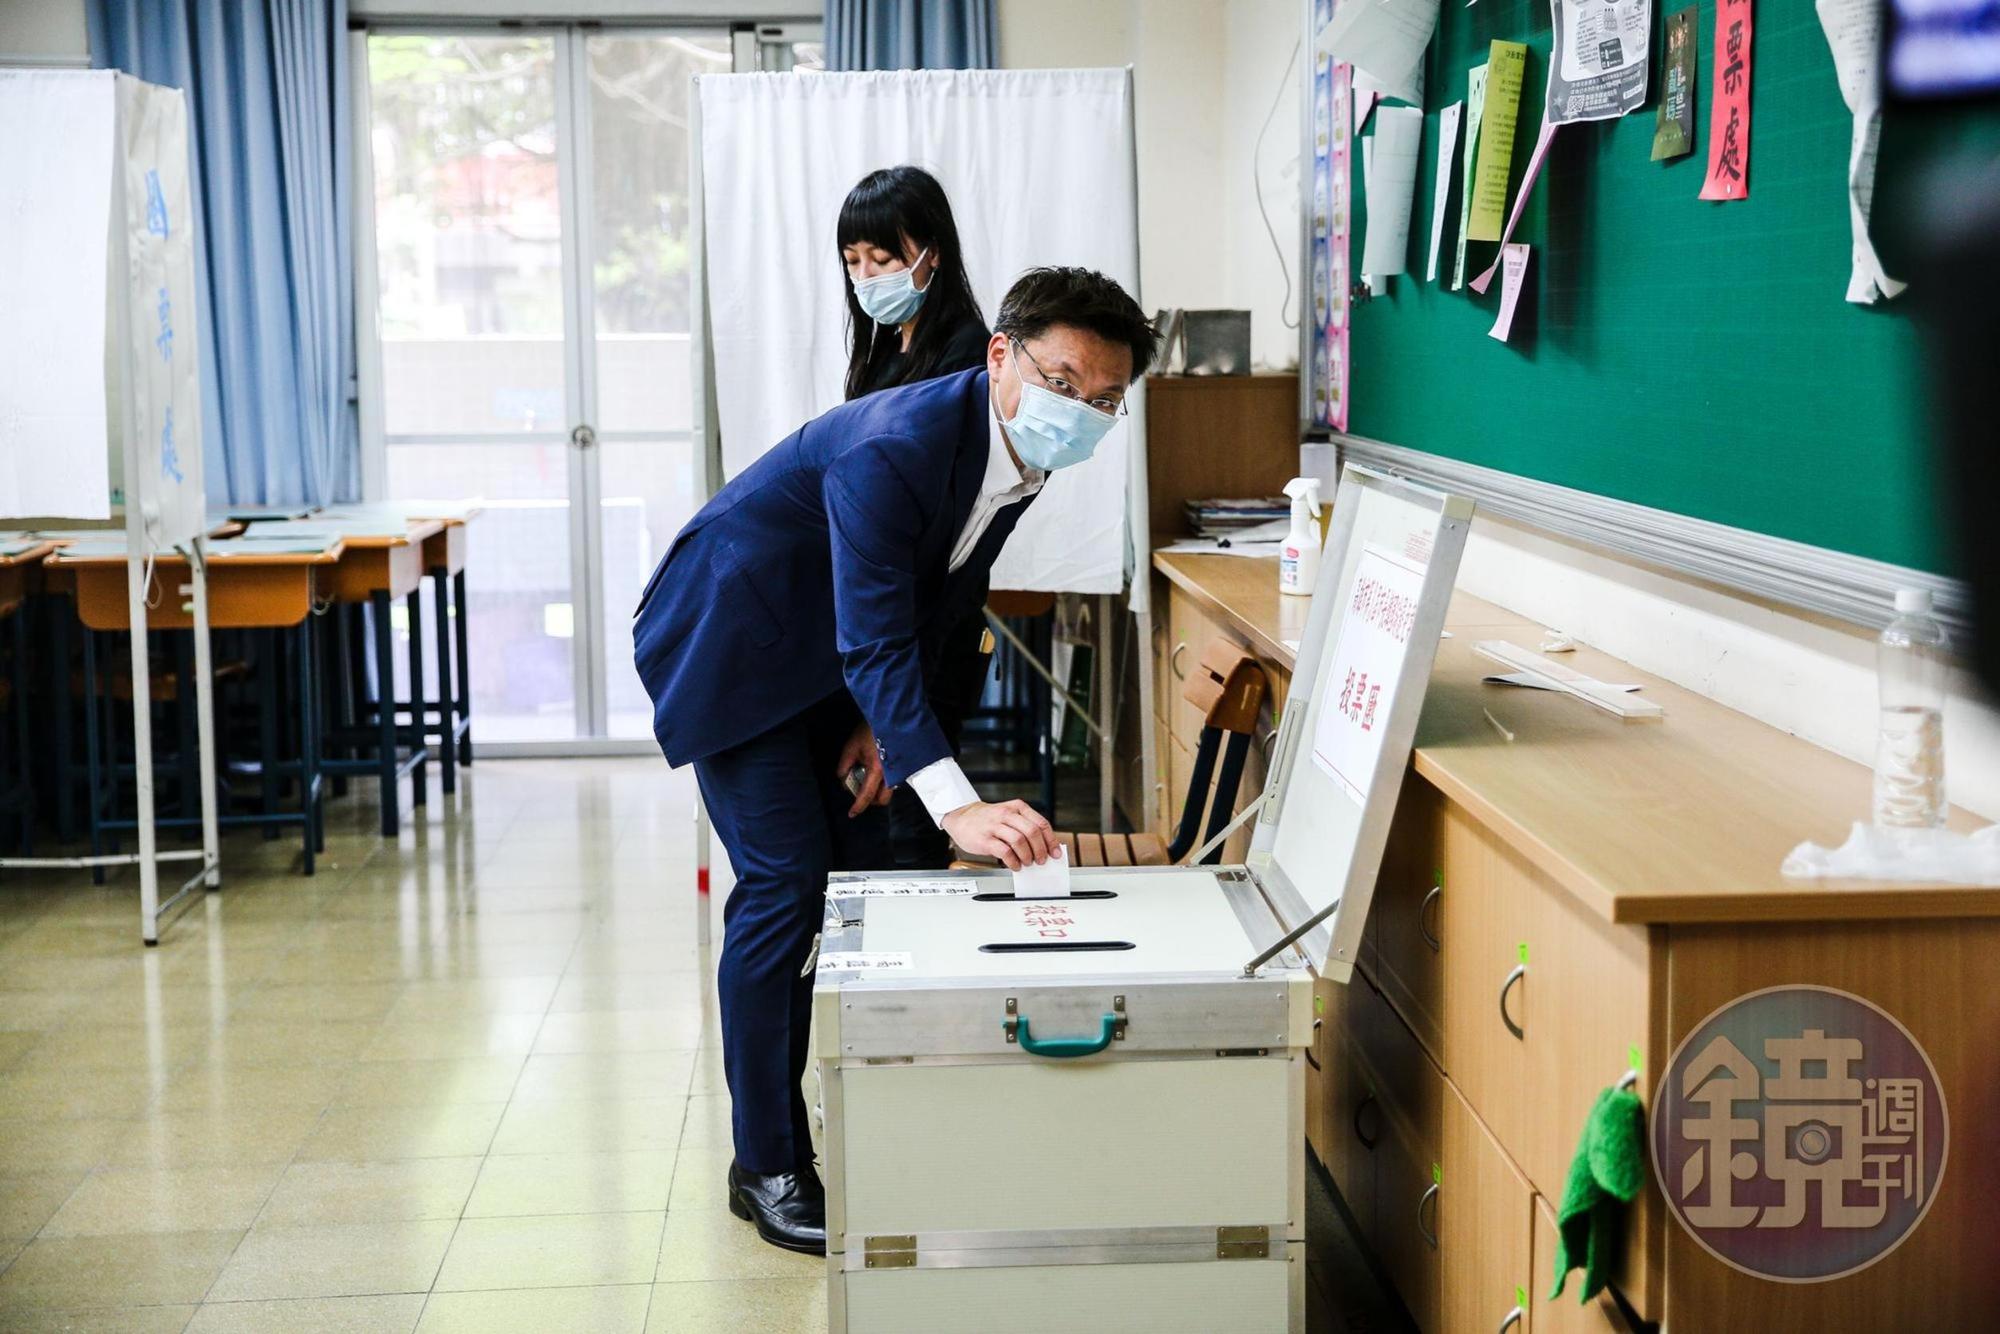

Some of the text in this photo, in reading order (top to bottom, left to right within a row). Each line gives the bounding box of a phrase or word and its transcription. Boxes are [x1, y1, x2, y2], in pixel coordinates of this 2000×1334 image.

[1715, 0, 1747, 181] 票處
[1022, 904, 1075, 937] 投票口
